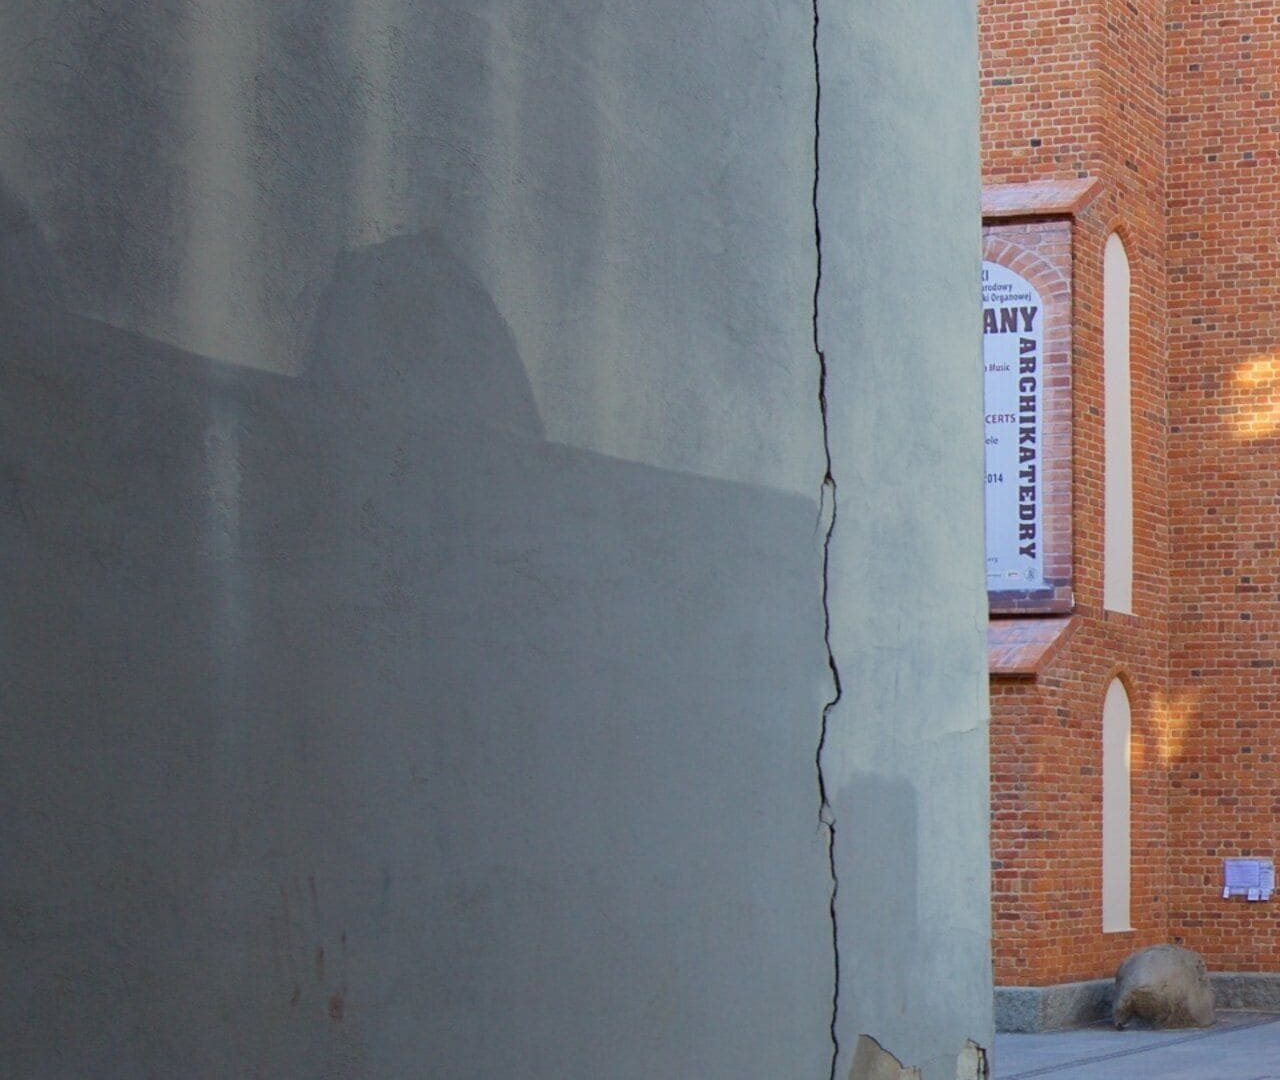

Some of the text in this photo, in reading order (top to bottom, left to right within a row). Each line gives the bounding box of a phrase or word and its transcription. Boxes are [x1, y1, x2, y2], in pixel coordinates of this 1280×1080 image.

[991, 291, 1032, 303] Organowej
[985, 413, 1016, 424] CERTS
[1019, 337, 1037, 559] ARCHIKATEDRY
